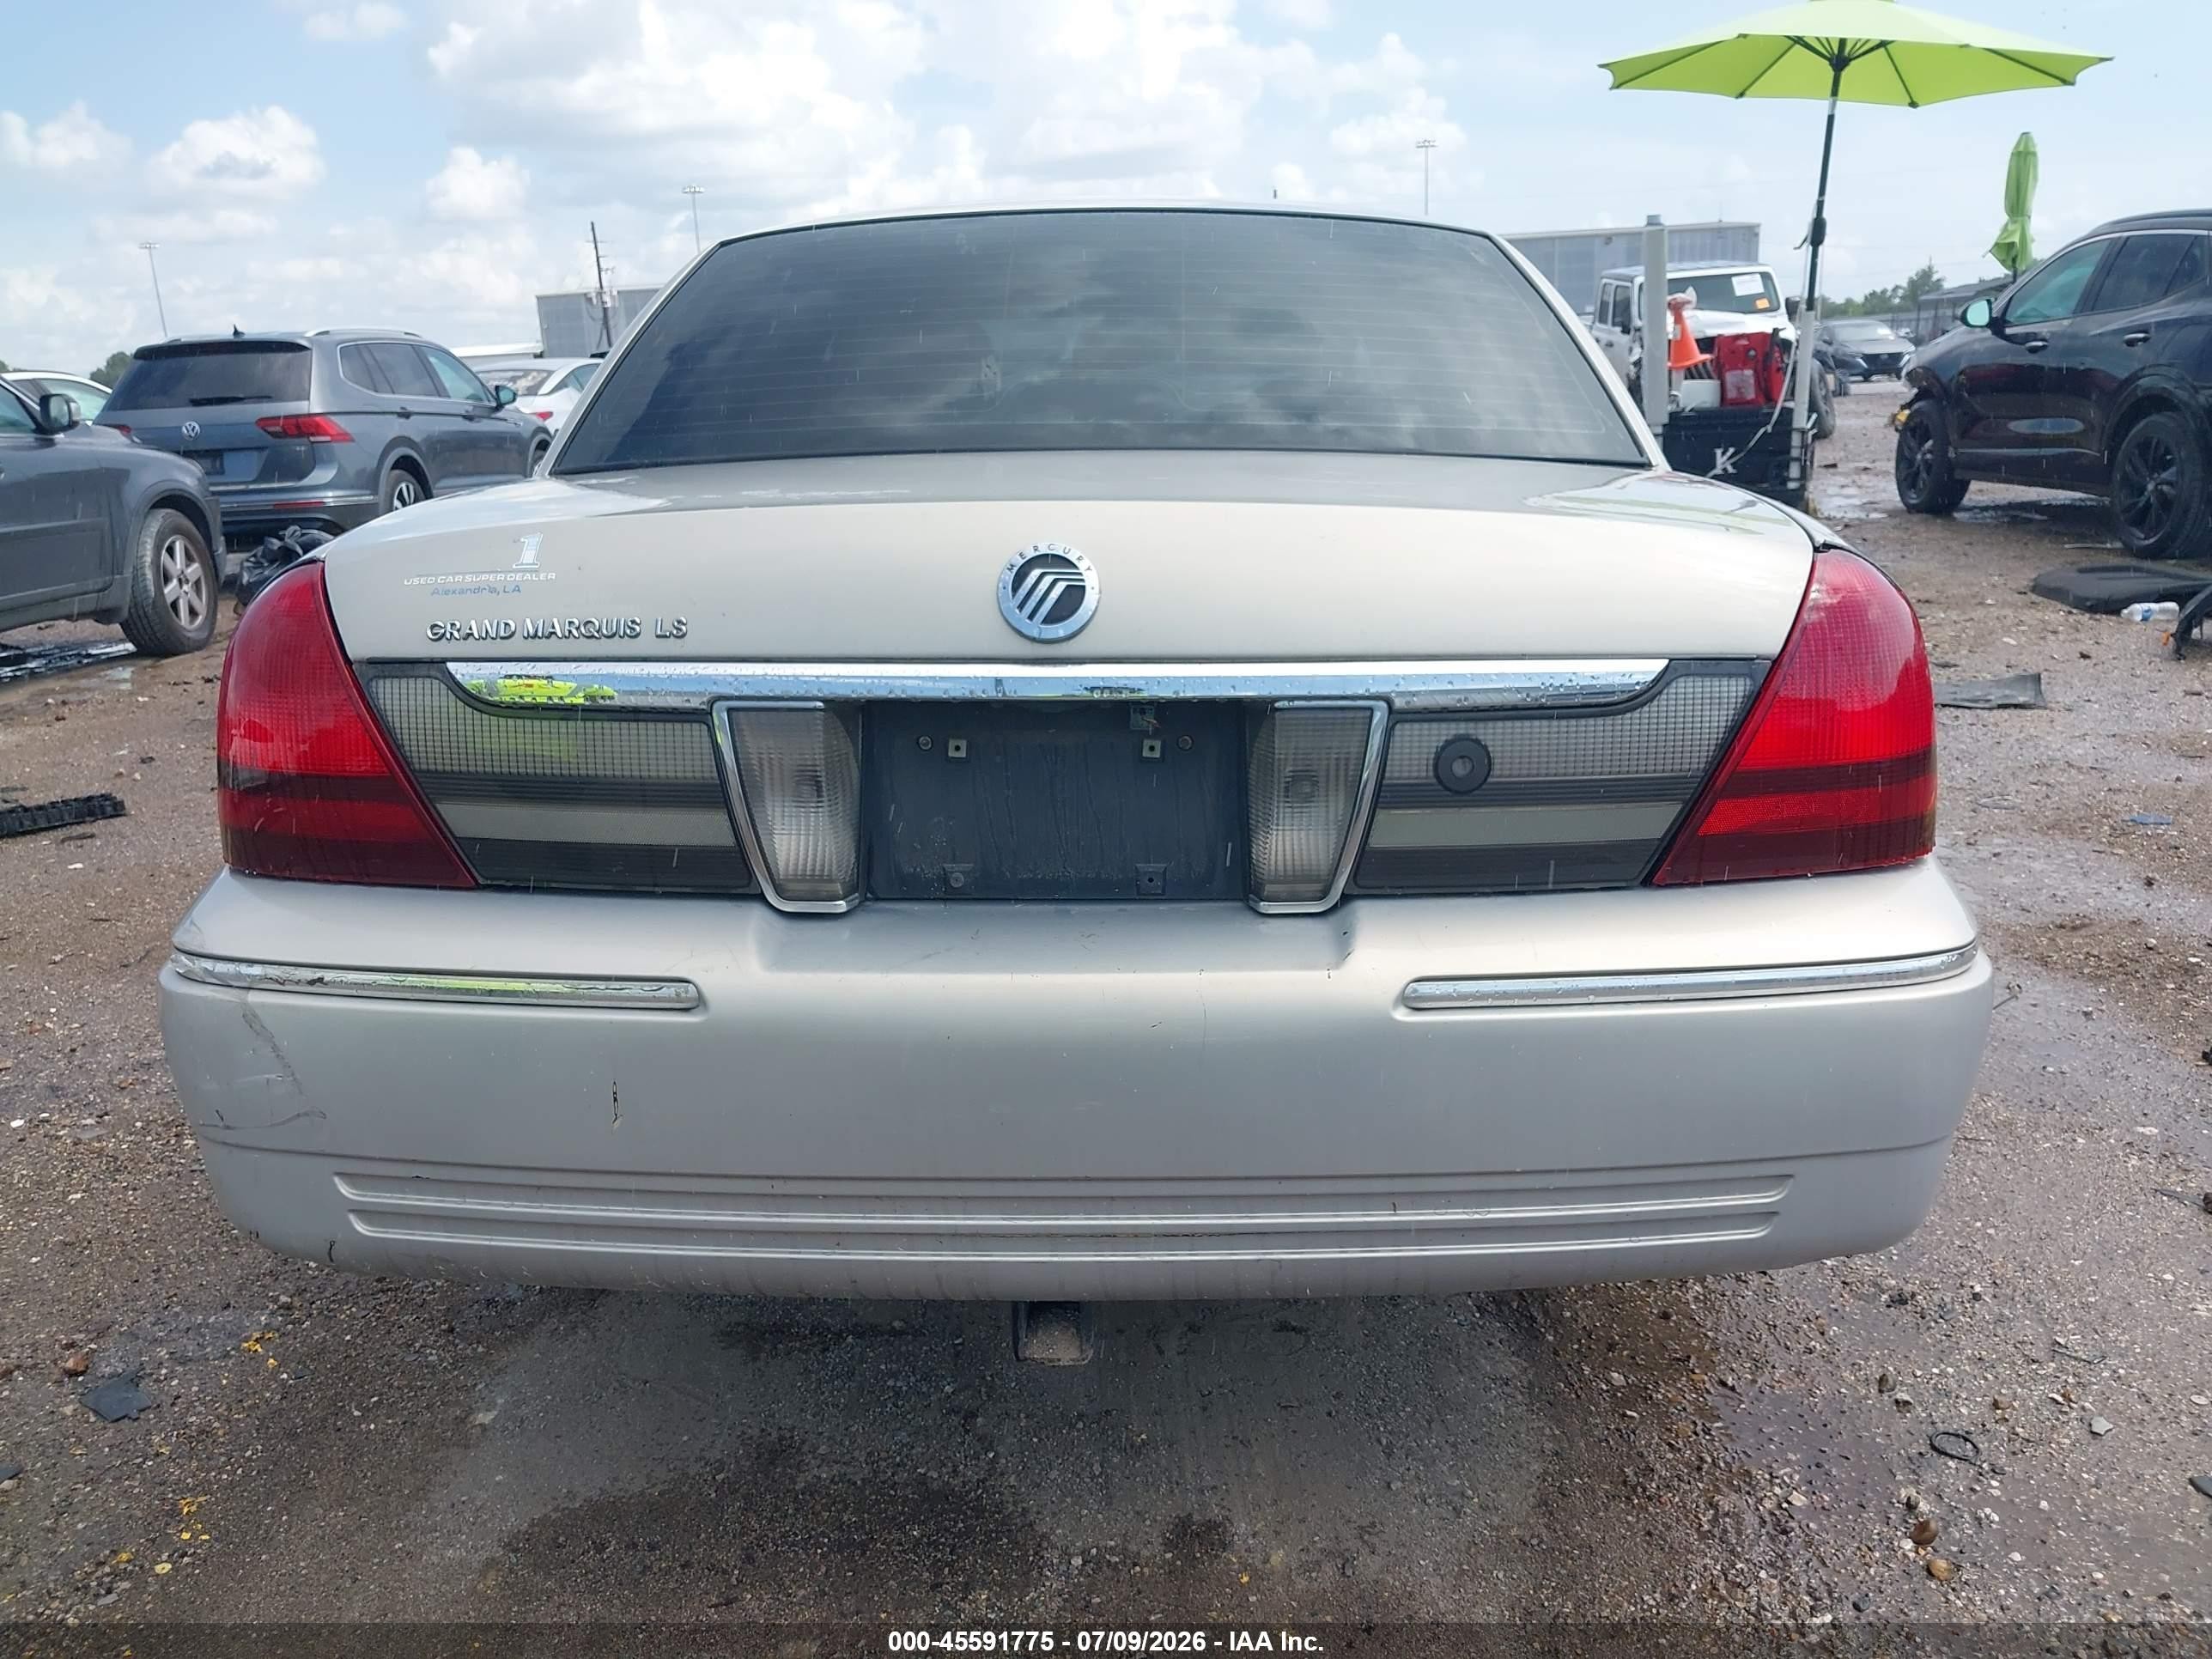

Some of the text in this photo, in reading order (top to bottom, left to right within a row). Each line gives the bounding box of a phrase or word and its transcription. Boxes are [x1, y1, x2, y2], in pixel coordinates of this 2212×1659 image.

[513, 532, 544, 569] 1
[1006, 544, 1093, 574] MERCURY
[404, 572, 556, 586] USED CAR SUPER DEALER
[502, 584, 522, 595] LA
[426, 616, 688, 641] GRAND MARQUIS LS
